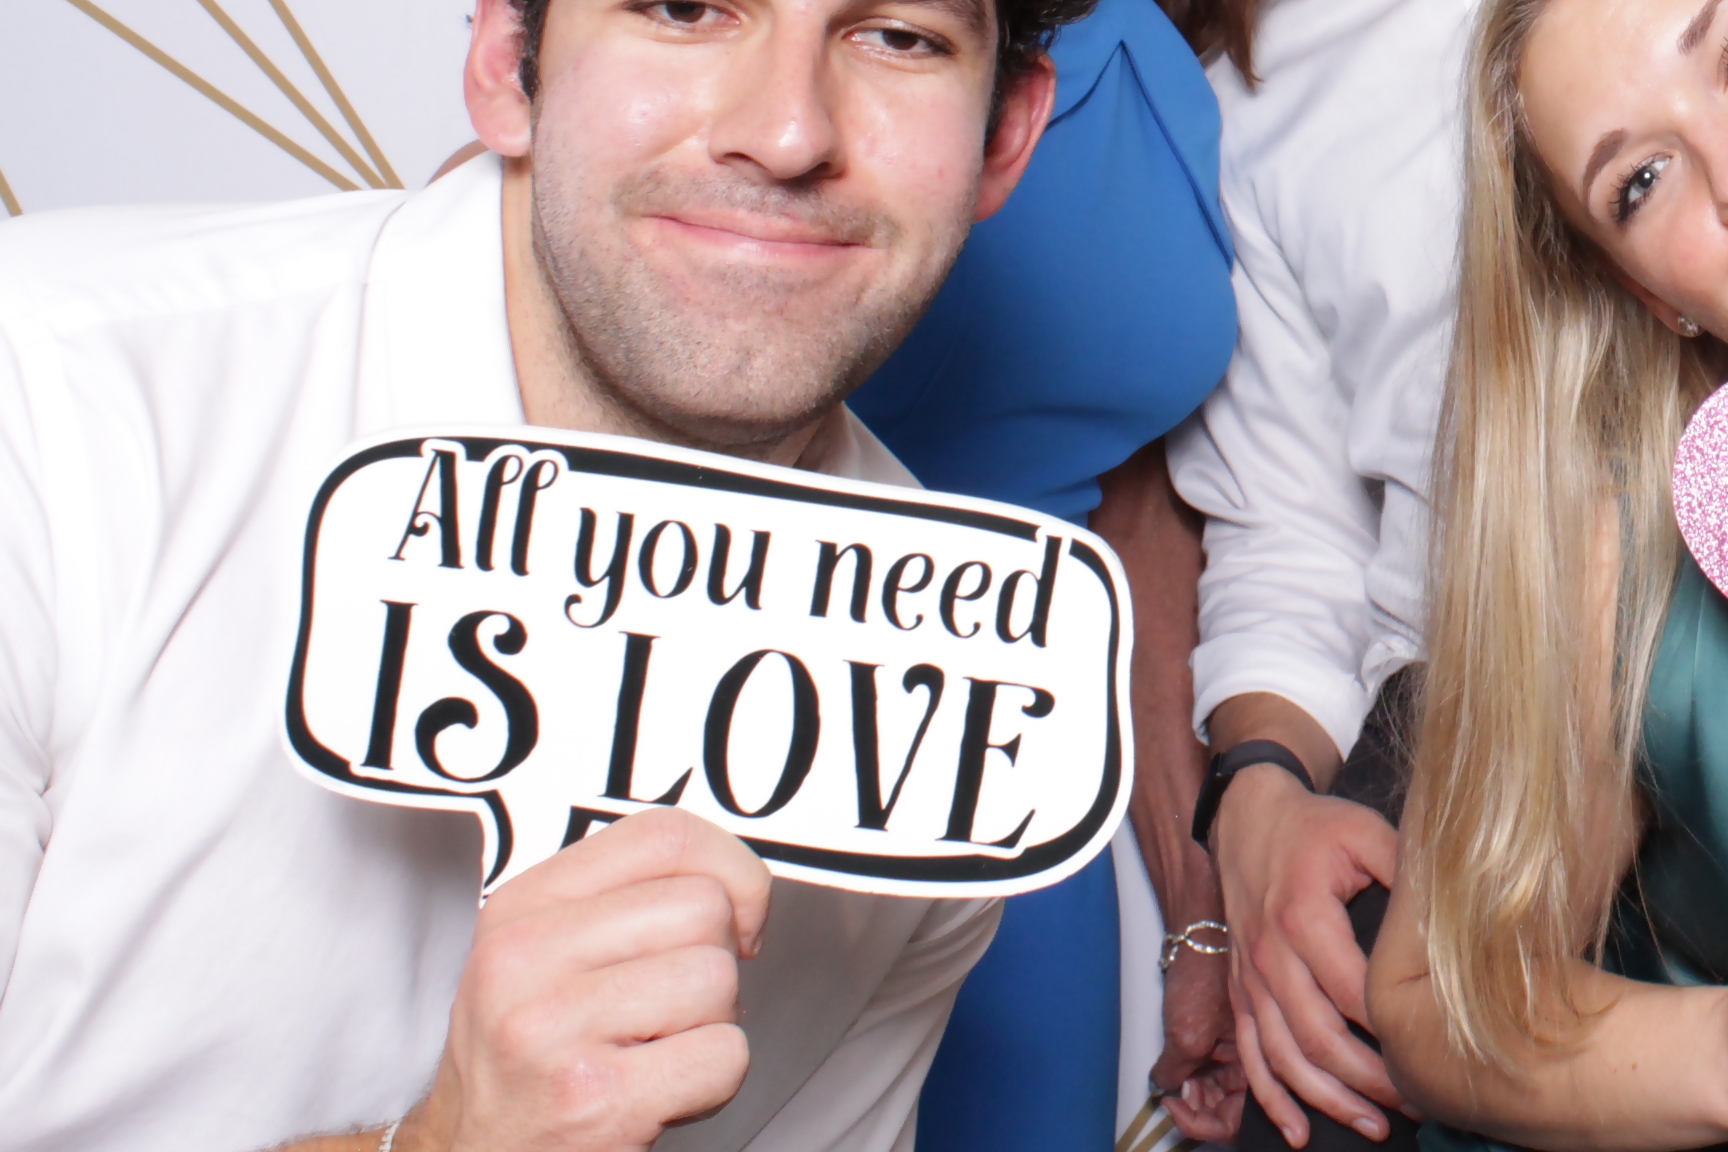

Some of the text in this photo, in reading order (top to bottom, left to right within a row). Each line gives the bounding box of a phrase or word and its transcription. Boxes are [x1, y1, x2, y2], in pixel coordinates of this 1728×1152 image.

[388, 449, 1063, 648] All you need
[360, 599, 1055, 845] IS LOVE
